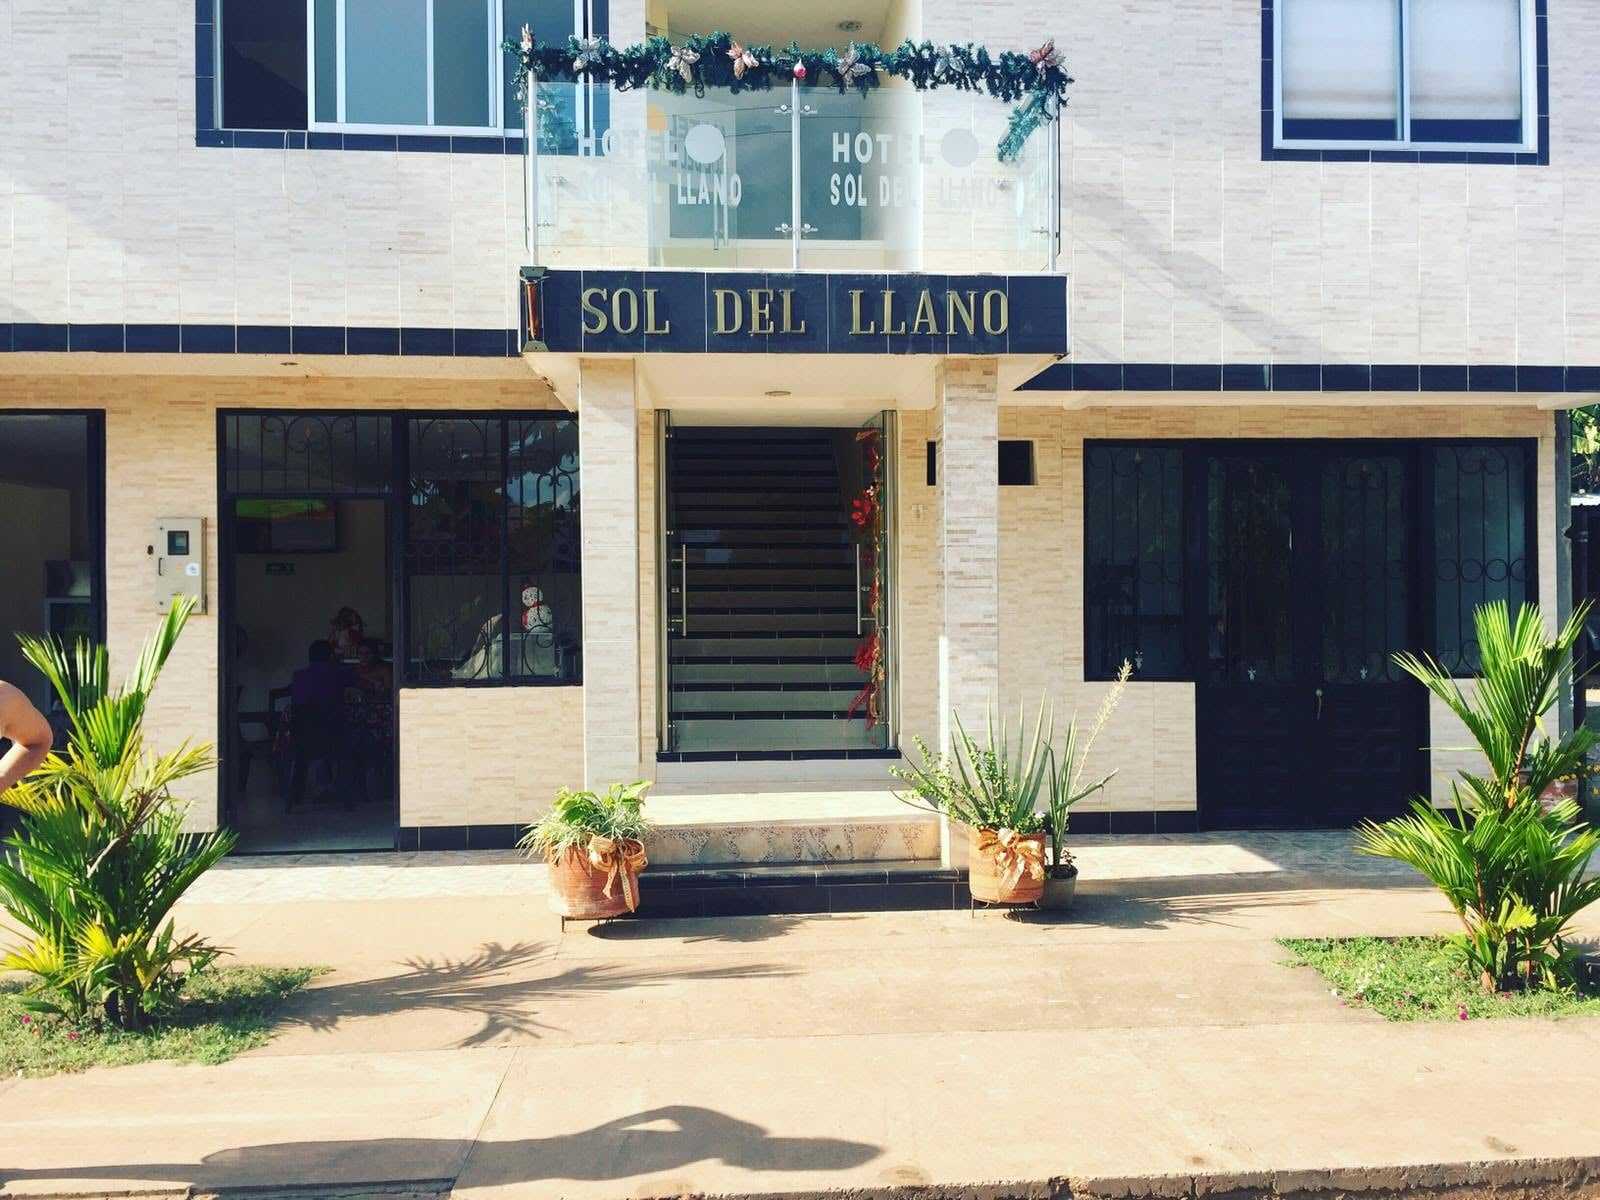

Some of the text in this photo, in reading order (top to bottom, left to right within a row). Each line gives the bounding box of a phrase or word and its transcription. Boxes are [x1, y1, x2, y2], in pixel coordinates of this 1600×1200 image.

[830, 173, 867, 206] SOL
[581, 287, 1010, 337] SOL DEL LLANO
